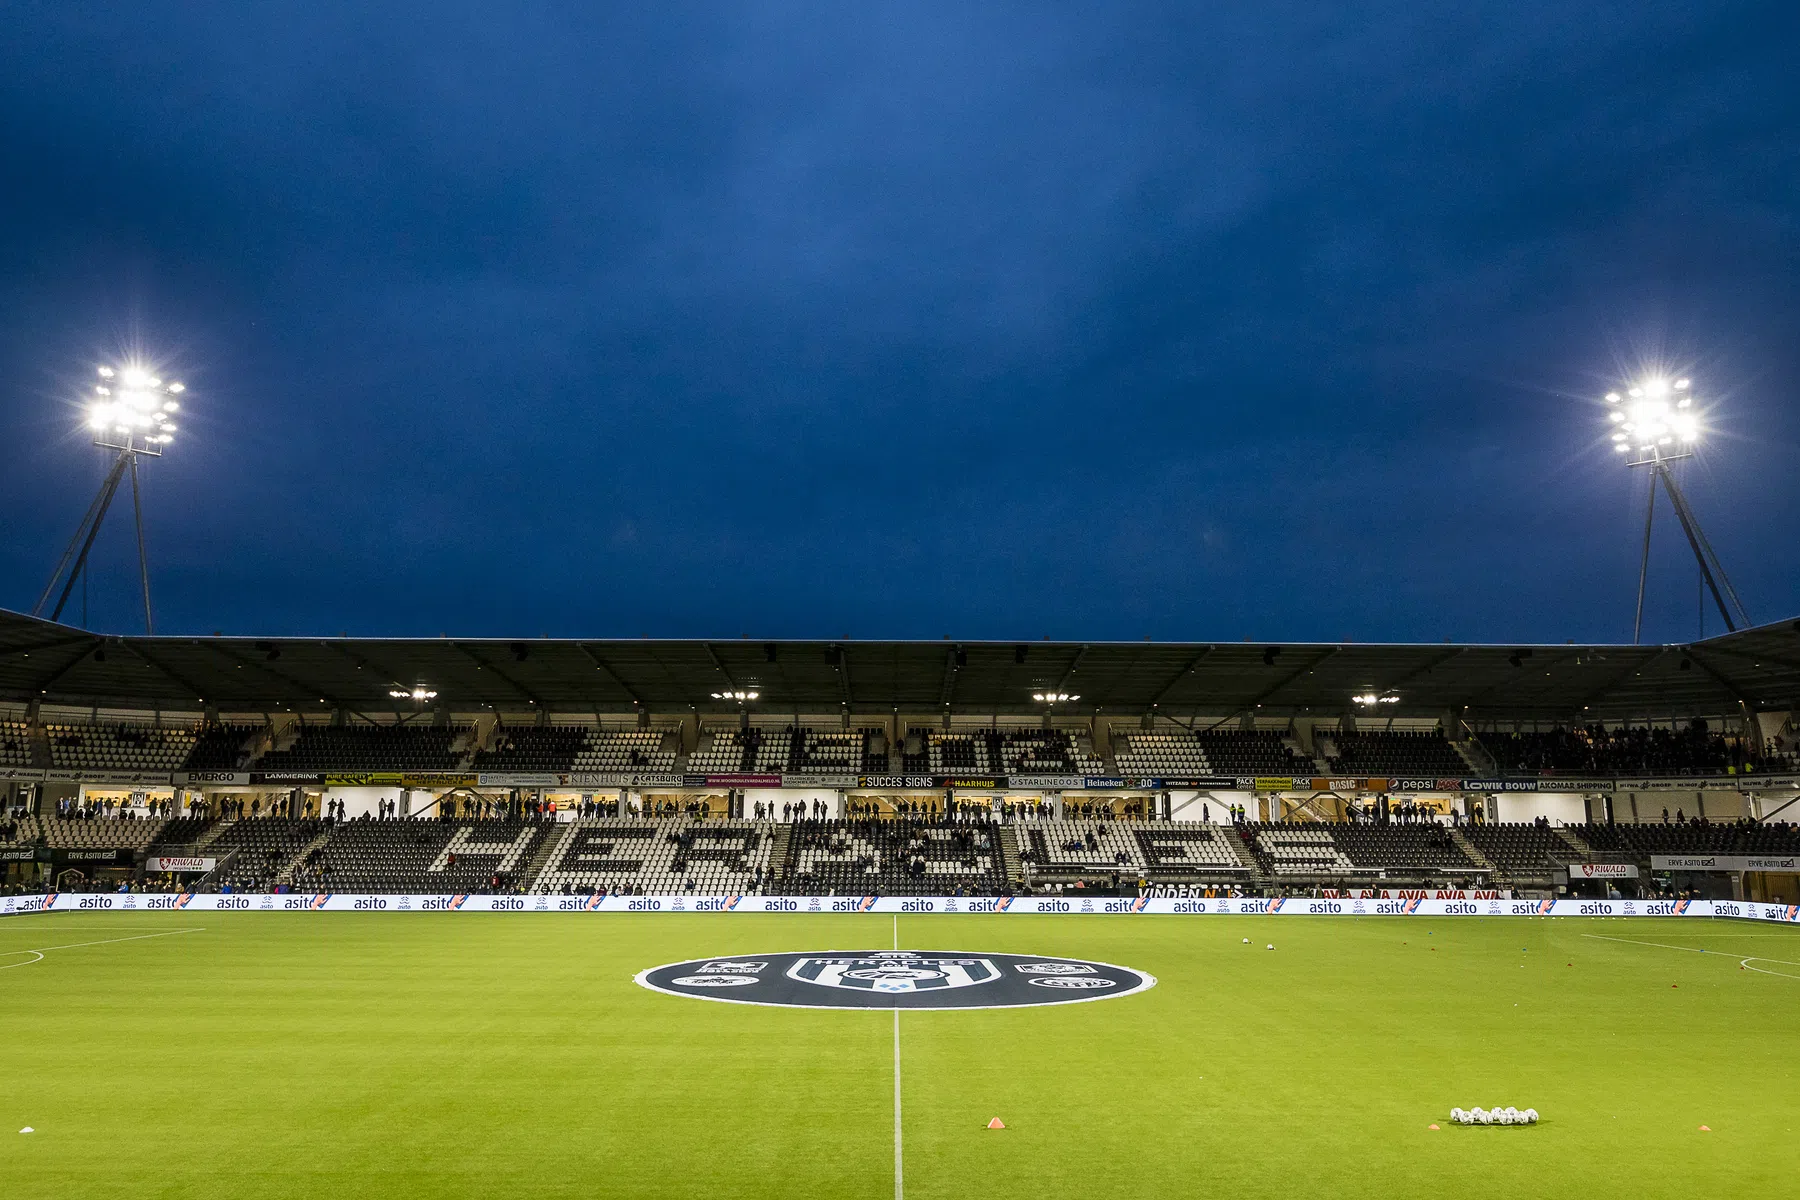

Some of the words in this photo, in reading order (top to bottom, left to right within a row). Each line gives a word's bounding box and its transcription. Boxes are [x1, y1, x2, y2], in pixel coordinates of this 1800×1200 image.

[188, 773, 234, 781] EMERGO
[571, 774, 629, 783] KIENHUIS
[640, 775, 682, 783] CATSBURG
[866, 777, 902, 787] SUCCES
[905, 777, 933, 787] SIGNS
[1087, 779, 1124, 787] Heineken
[1329, 779, 1356, 790] BASIC
[1402, 780, 1434, 790] pepsi
[1436, 779, 1462, 790] MAX
[1505, 782, 1536, 790] BOUW
[1539, 780, 1575, 789] AKOMAR
[1576, 780, 1612, 789] SHIPPING
[68, 851, 83, 859] ERVE
[84, 851, 102, 859] ASITO
[169, 858, 203, 866] RIWALD
[1594, 864, 1626, 873] RIWALD
[1138, 888, 1200, 898] VINDEN
[1322, 889, 1353, 899] AVA
[1398, 889, 1428, 899] AVIA
[1435, 890, 1466, 899] AVIA
[1473, 890, 1502, 899] AVI
[80, 895, 112, 909] asito
[217, 896, 249, 910] asito
[354, 896, 386, 910] asito
[491, 897, 523, 911] asito
[628, 898, 660, 912] asito
[765, 898, 797, 912] asito
[901, 899, 933, 913] asito
[1038, 899, 1070, 913] asito
[1174, 900, 1206, 914] asito
[1310, 901, 1342, 915] asito
[1446, 901, 1478, 915] asito
[1581, 902, 1613, 916] asito
[1715, 902, 1740, 915] asito
